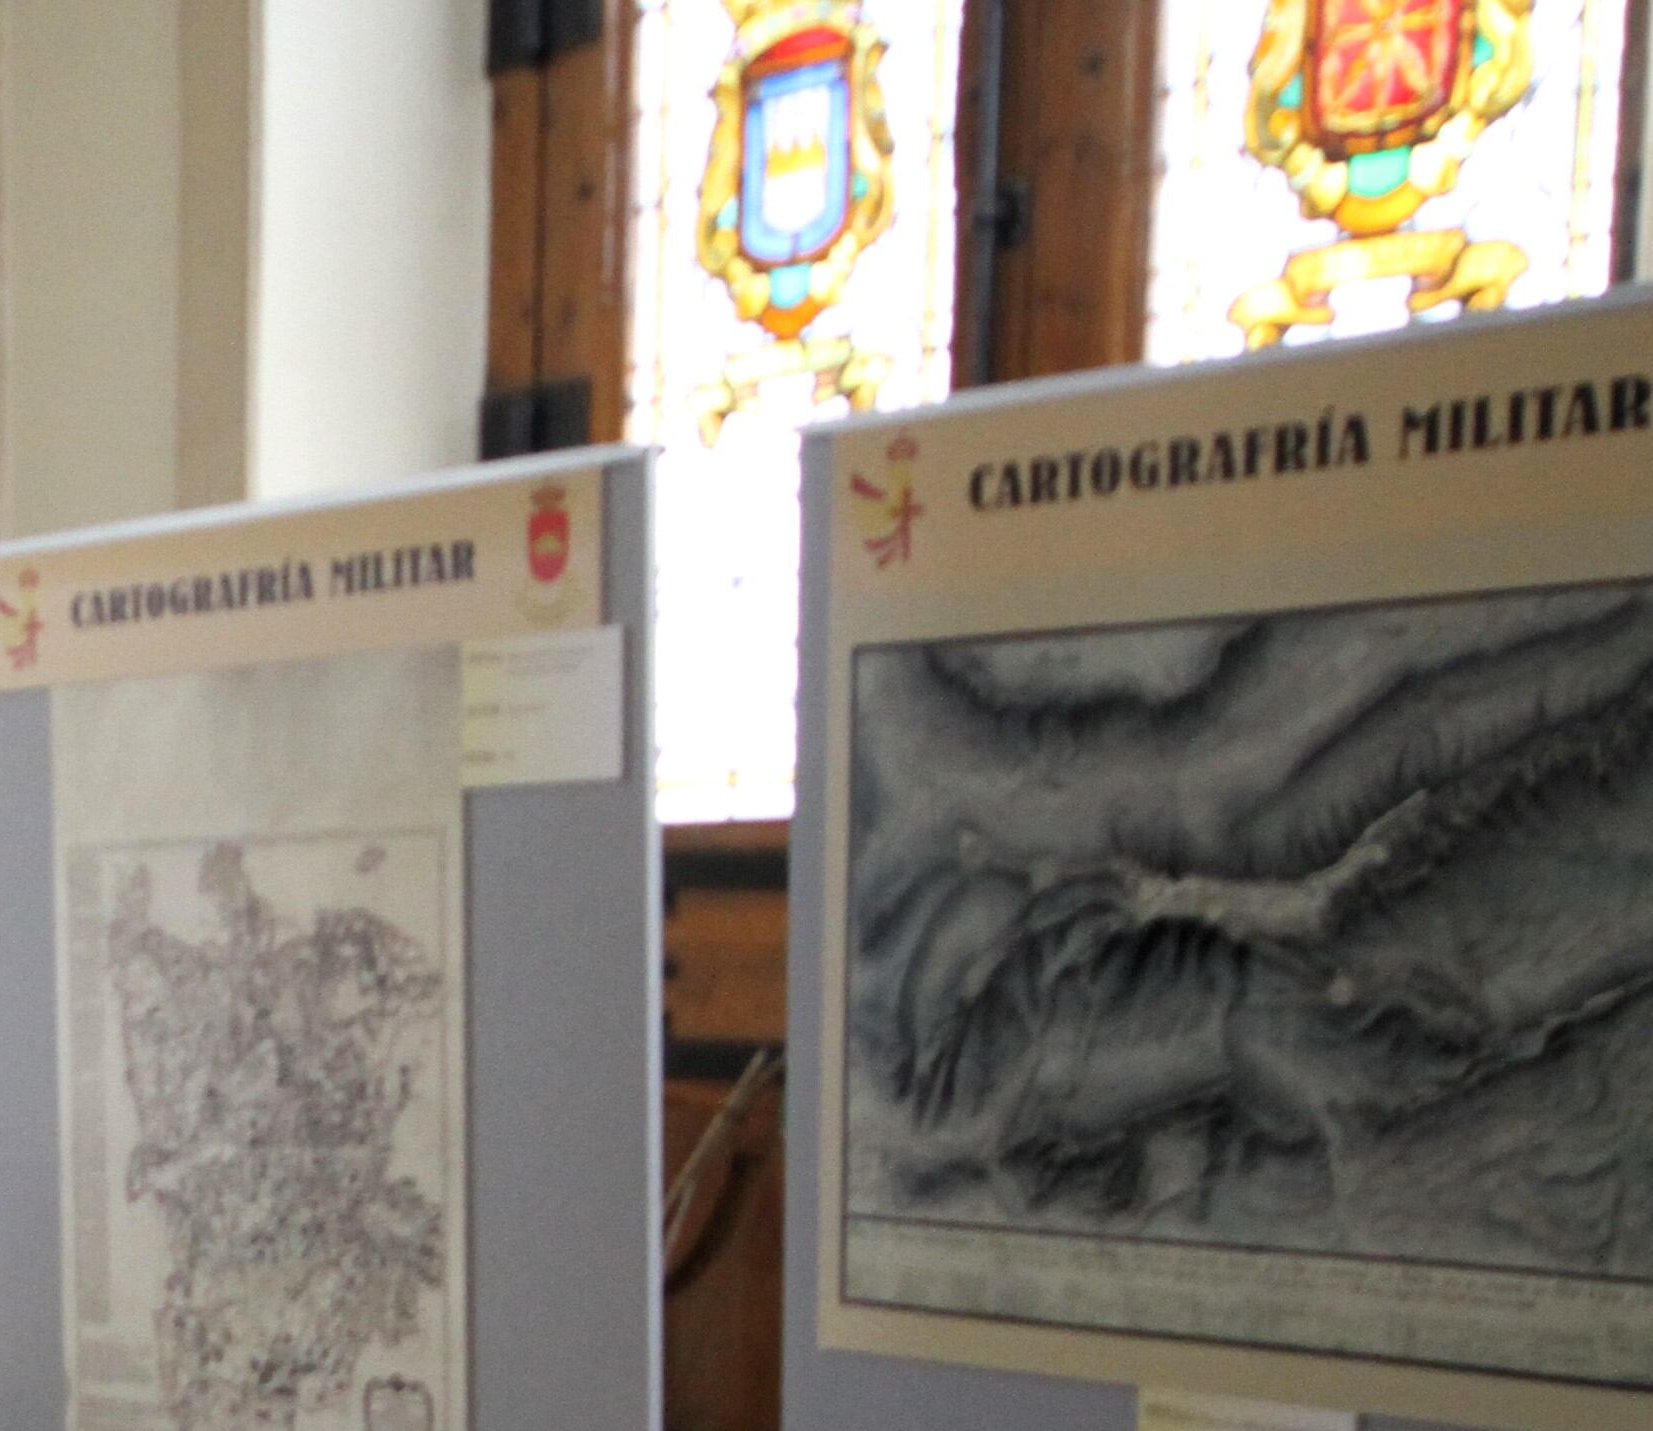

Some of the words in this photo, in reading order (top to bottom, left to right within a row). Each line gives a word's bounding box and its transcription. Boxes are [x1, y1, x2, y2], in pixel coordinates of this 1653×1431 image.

[968, 404, 1371, 512] CARTOGRAFRÍA
[1399, 374, 1653, 460] MILITAR
[70, 557, 315, 629] CARTOGRAFRÍA
[330, 538, 476, 599] MILITAR
